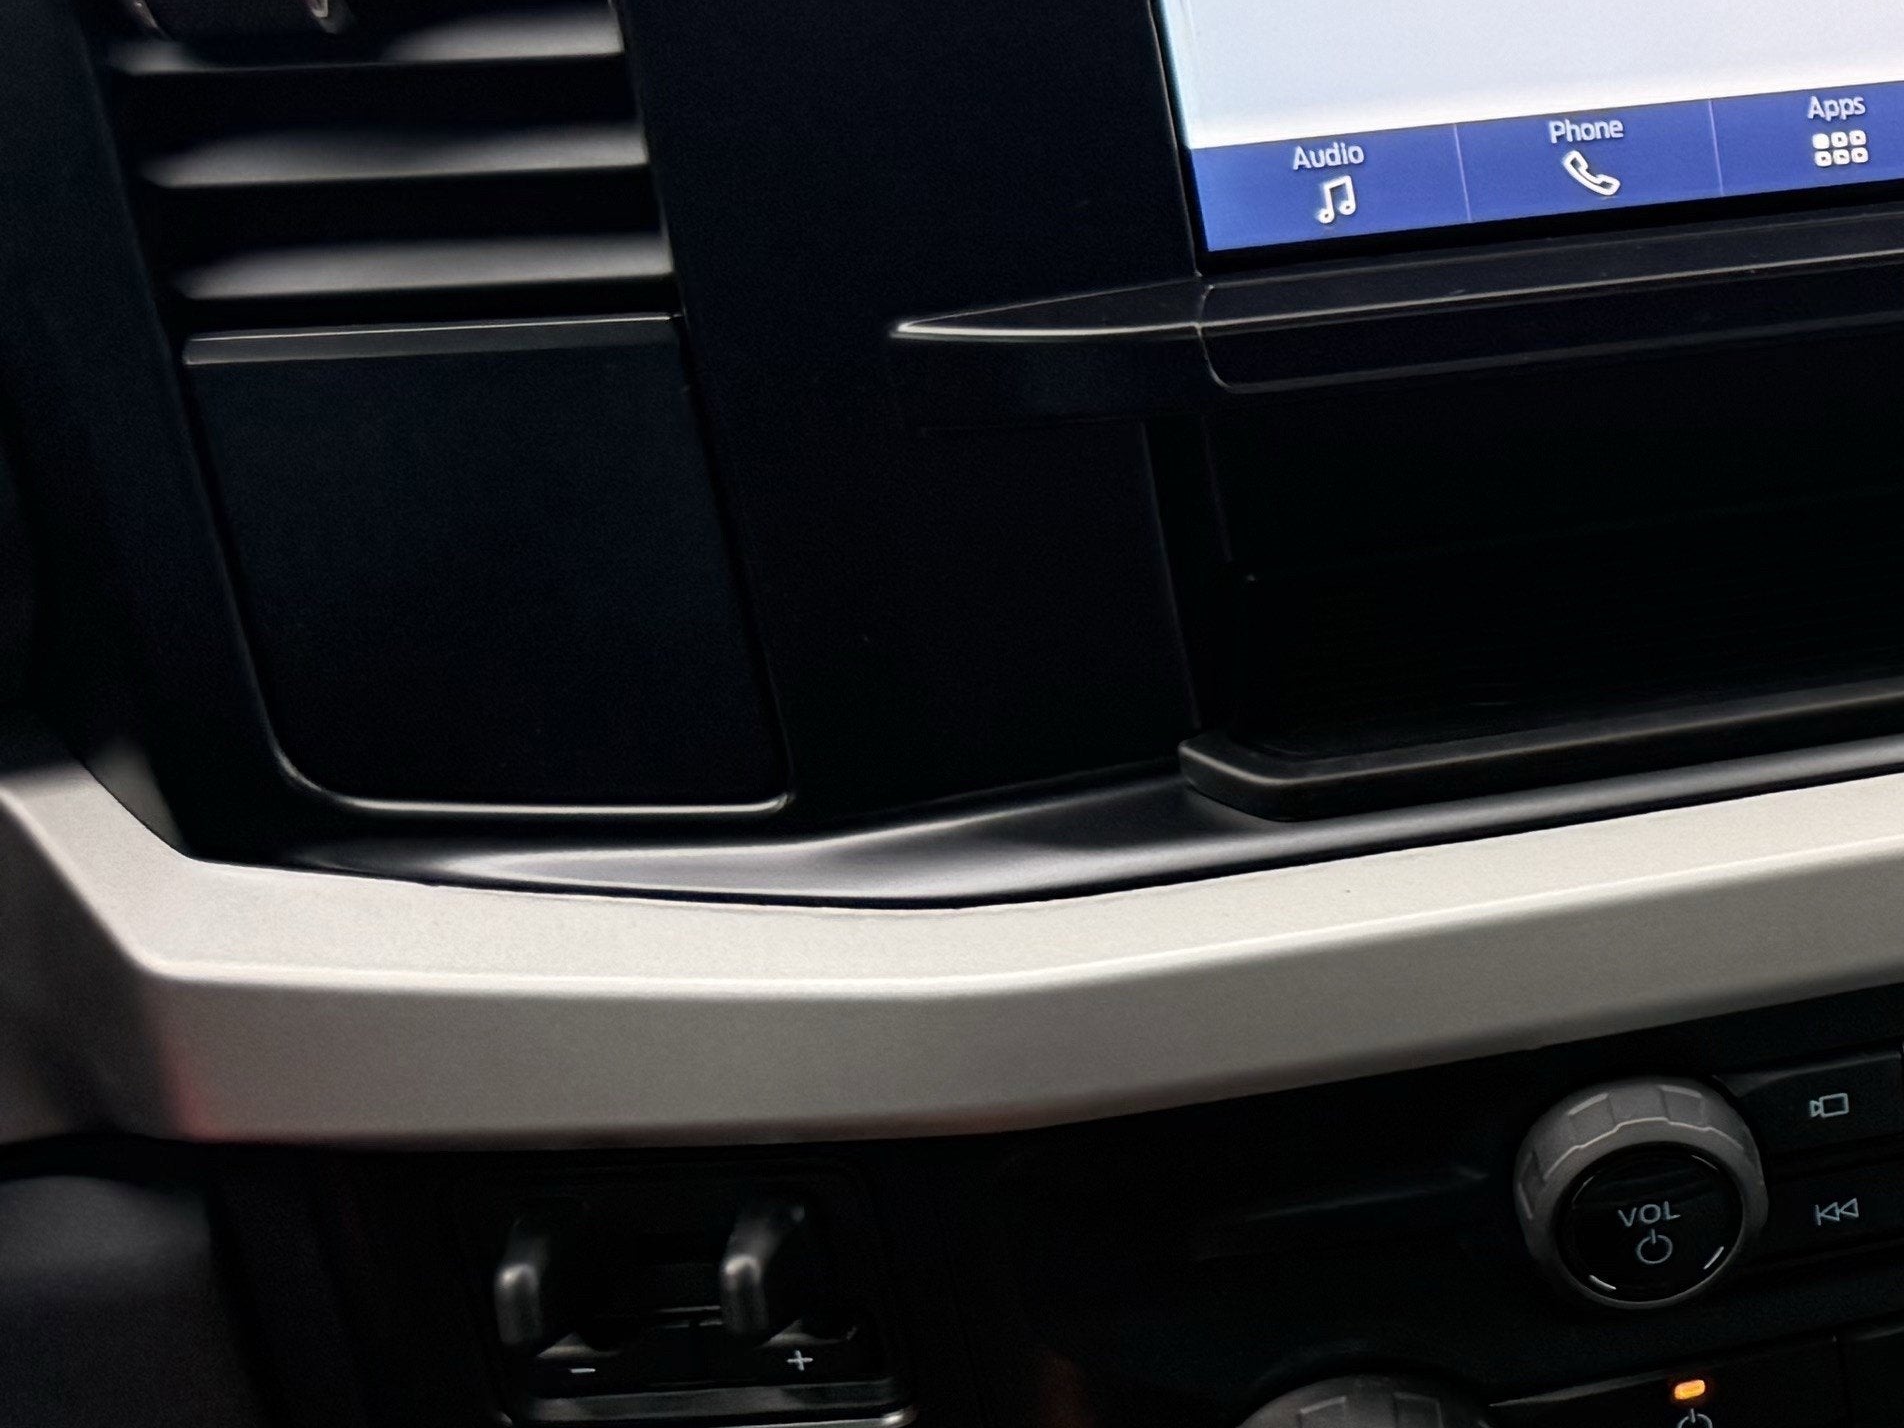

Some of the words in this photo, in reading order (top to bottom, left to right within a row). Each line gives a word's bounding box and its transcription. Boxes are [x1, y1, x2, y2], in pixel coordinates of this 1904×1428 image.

[1807, 93, 1867, 121] Apps
[1548, 119, 1624, 145] Phone
[1292, 141, 1365, 171] Audio
[1617, 1200, 1681, 1228] VOL
